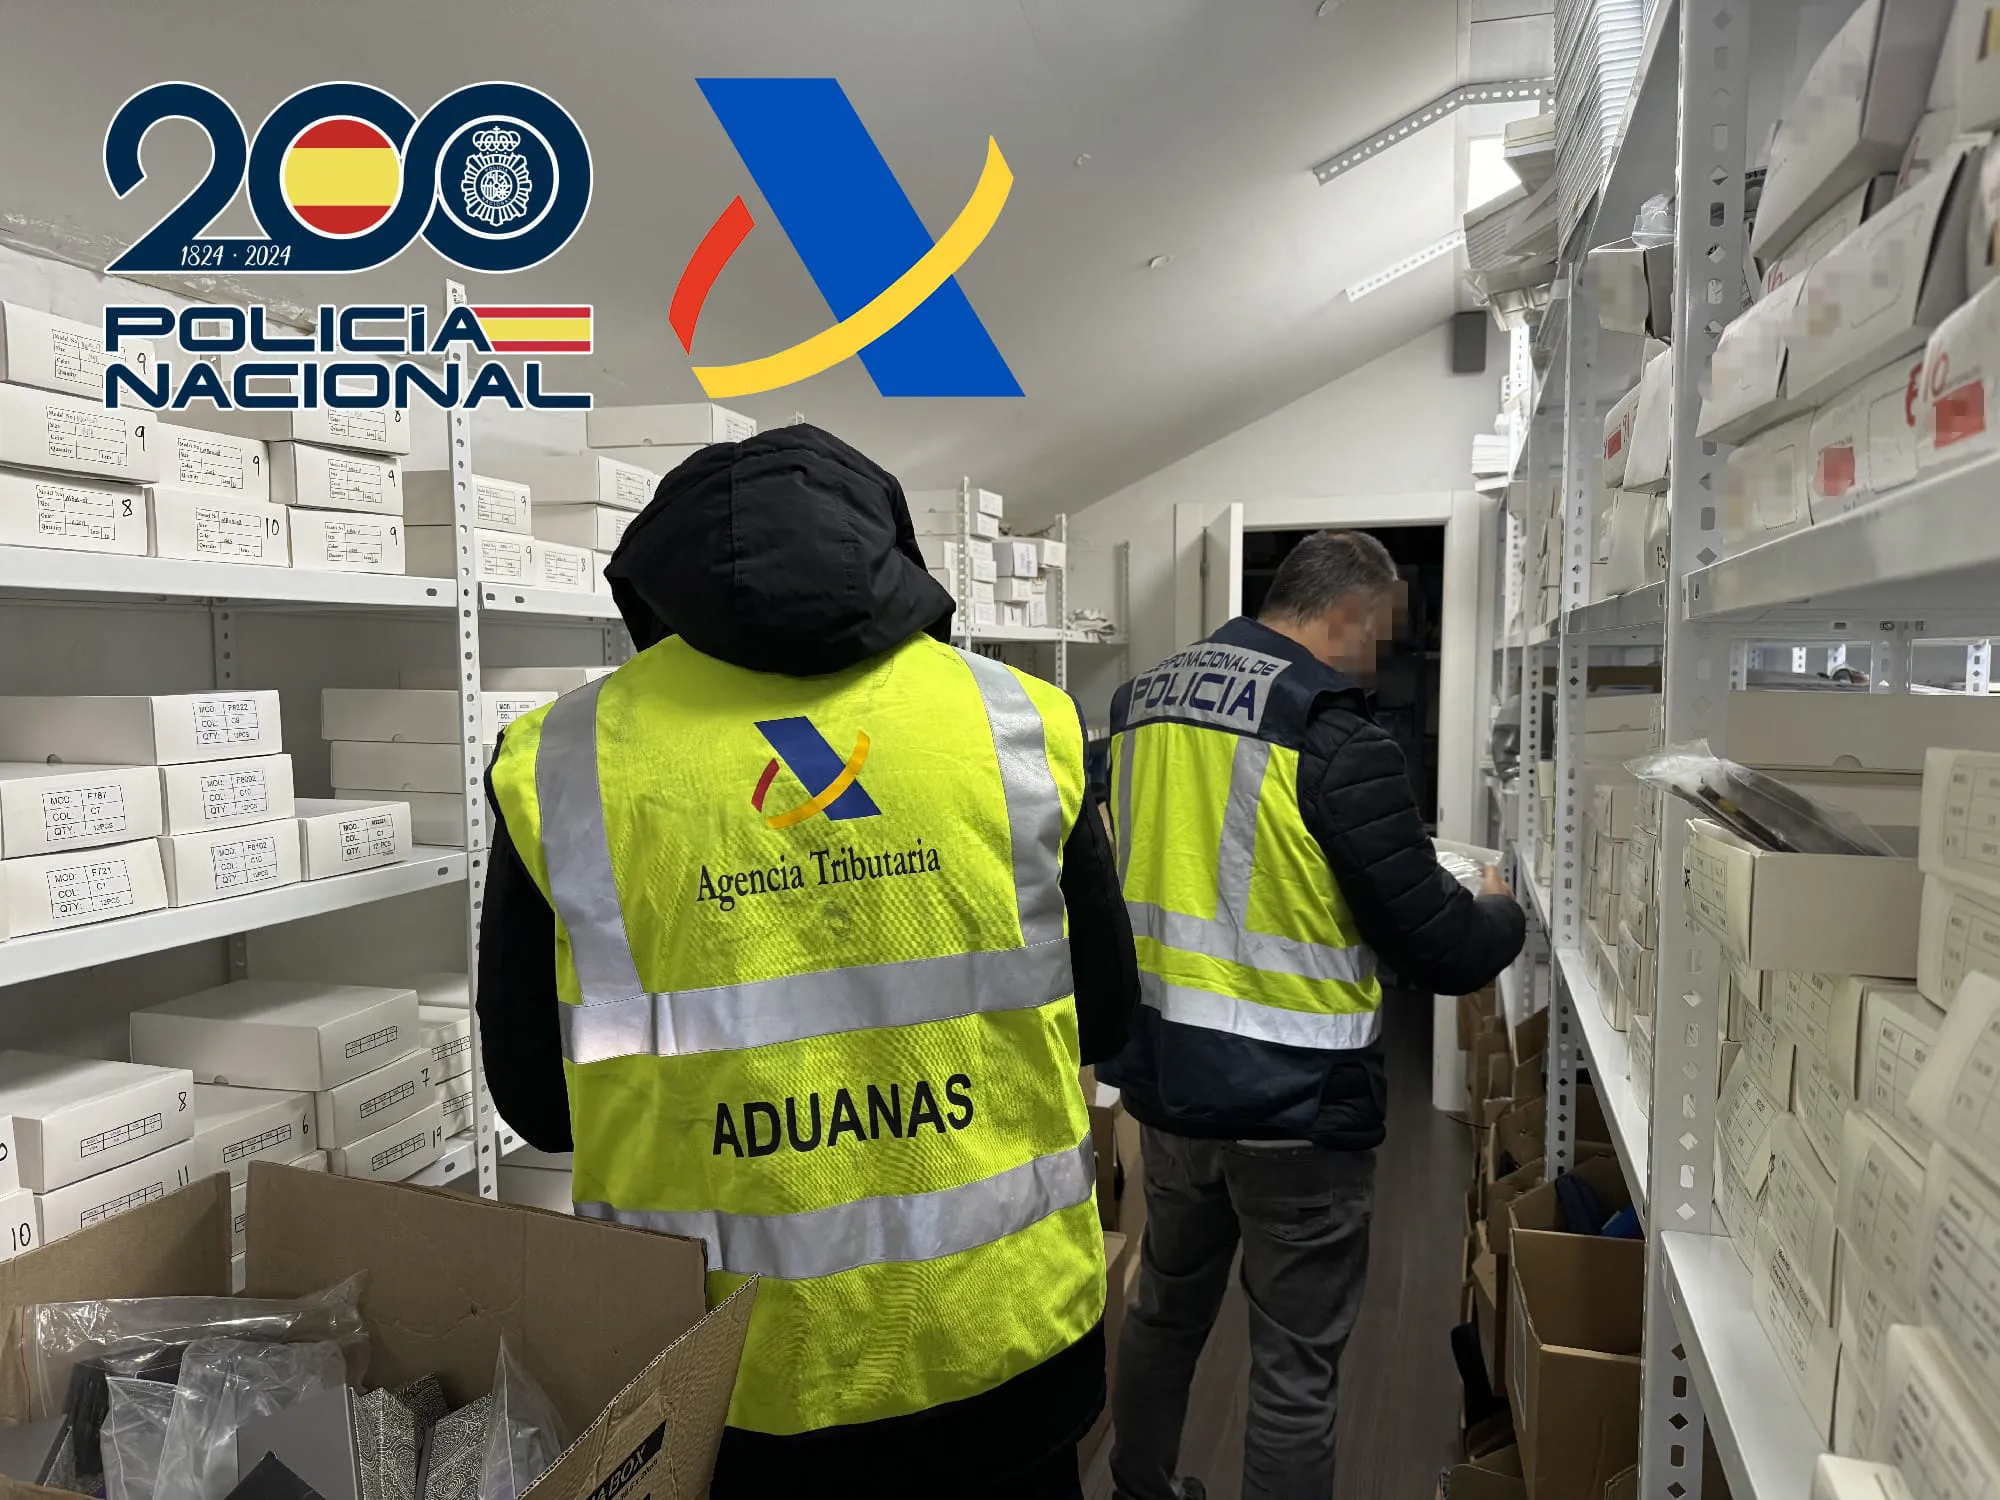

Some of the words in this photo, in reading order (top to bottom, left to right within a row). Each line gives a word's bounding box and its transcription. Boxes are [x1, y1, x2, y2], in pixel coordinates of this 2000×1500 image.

[137, 353, 147, 375] 9
[135, 426, 146, 452] 9
[253, 456, 260, 477] 9
[388, 470, 396, 487] 9
[122, 499, 132, 517] 8
[266, 518, 279, 539] 10
[390, 527, 398, 545] 9
[526, 545, 532, 564] 9
[1249, 660, 1279, 676] DE
[1131, 672, 1257, 721] POLICIA
[696, 854, 804, 912] Agencia
[809, 838, 941, 886] Tributaria
[421, 1067, 430, 1087] 7
[178, 1092, 186, 1111] 8
[303, 1113, 309, 1134] 6
[712, 1073, 974, 1158] ADUANAS
[433, 1126, 442, 1148] 19
[178, 1165, 189, 1187] 11
[12, 1222, 31, 1251] 10
